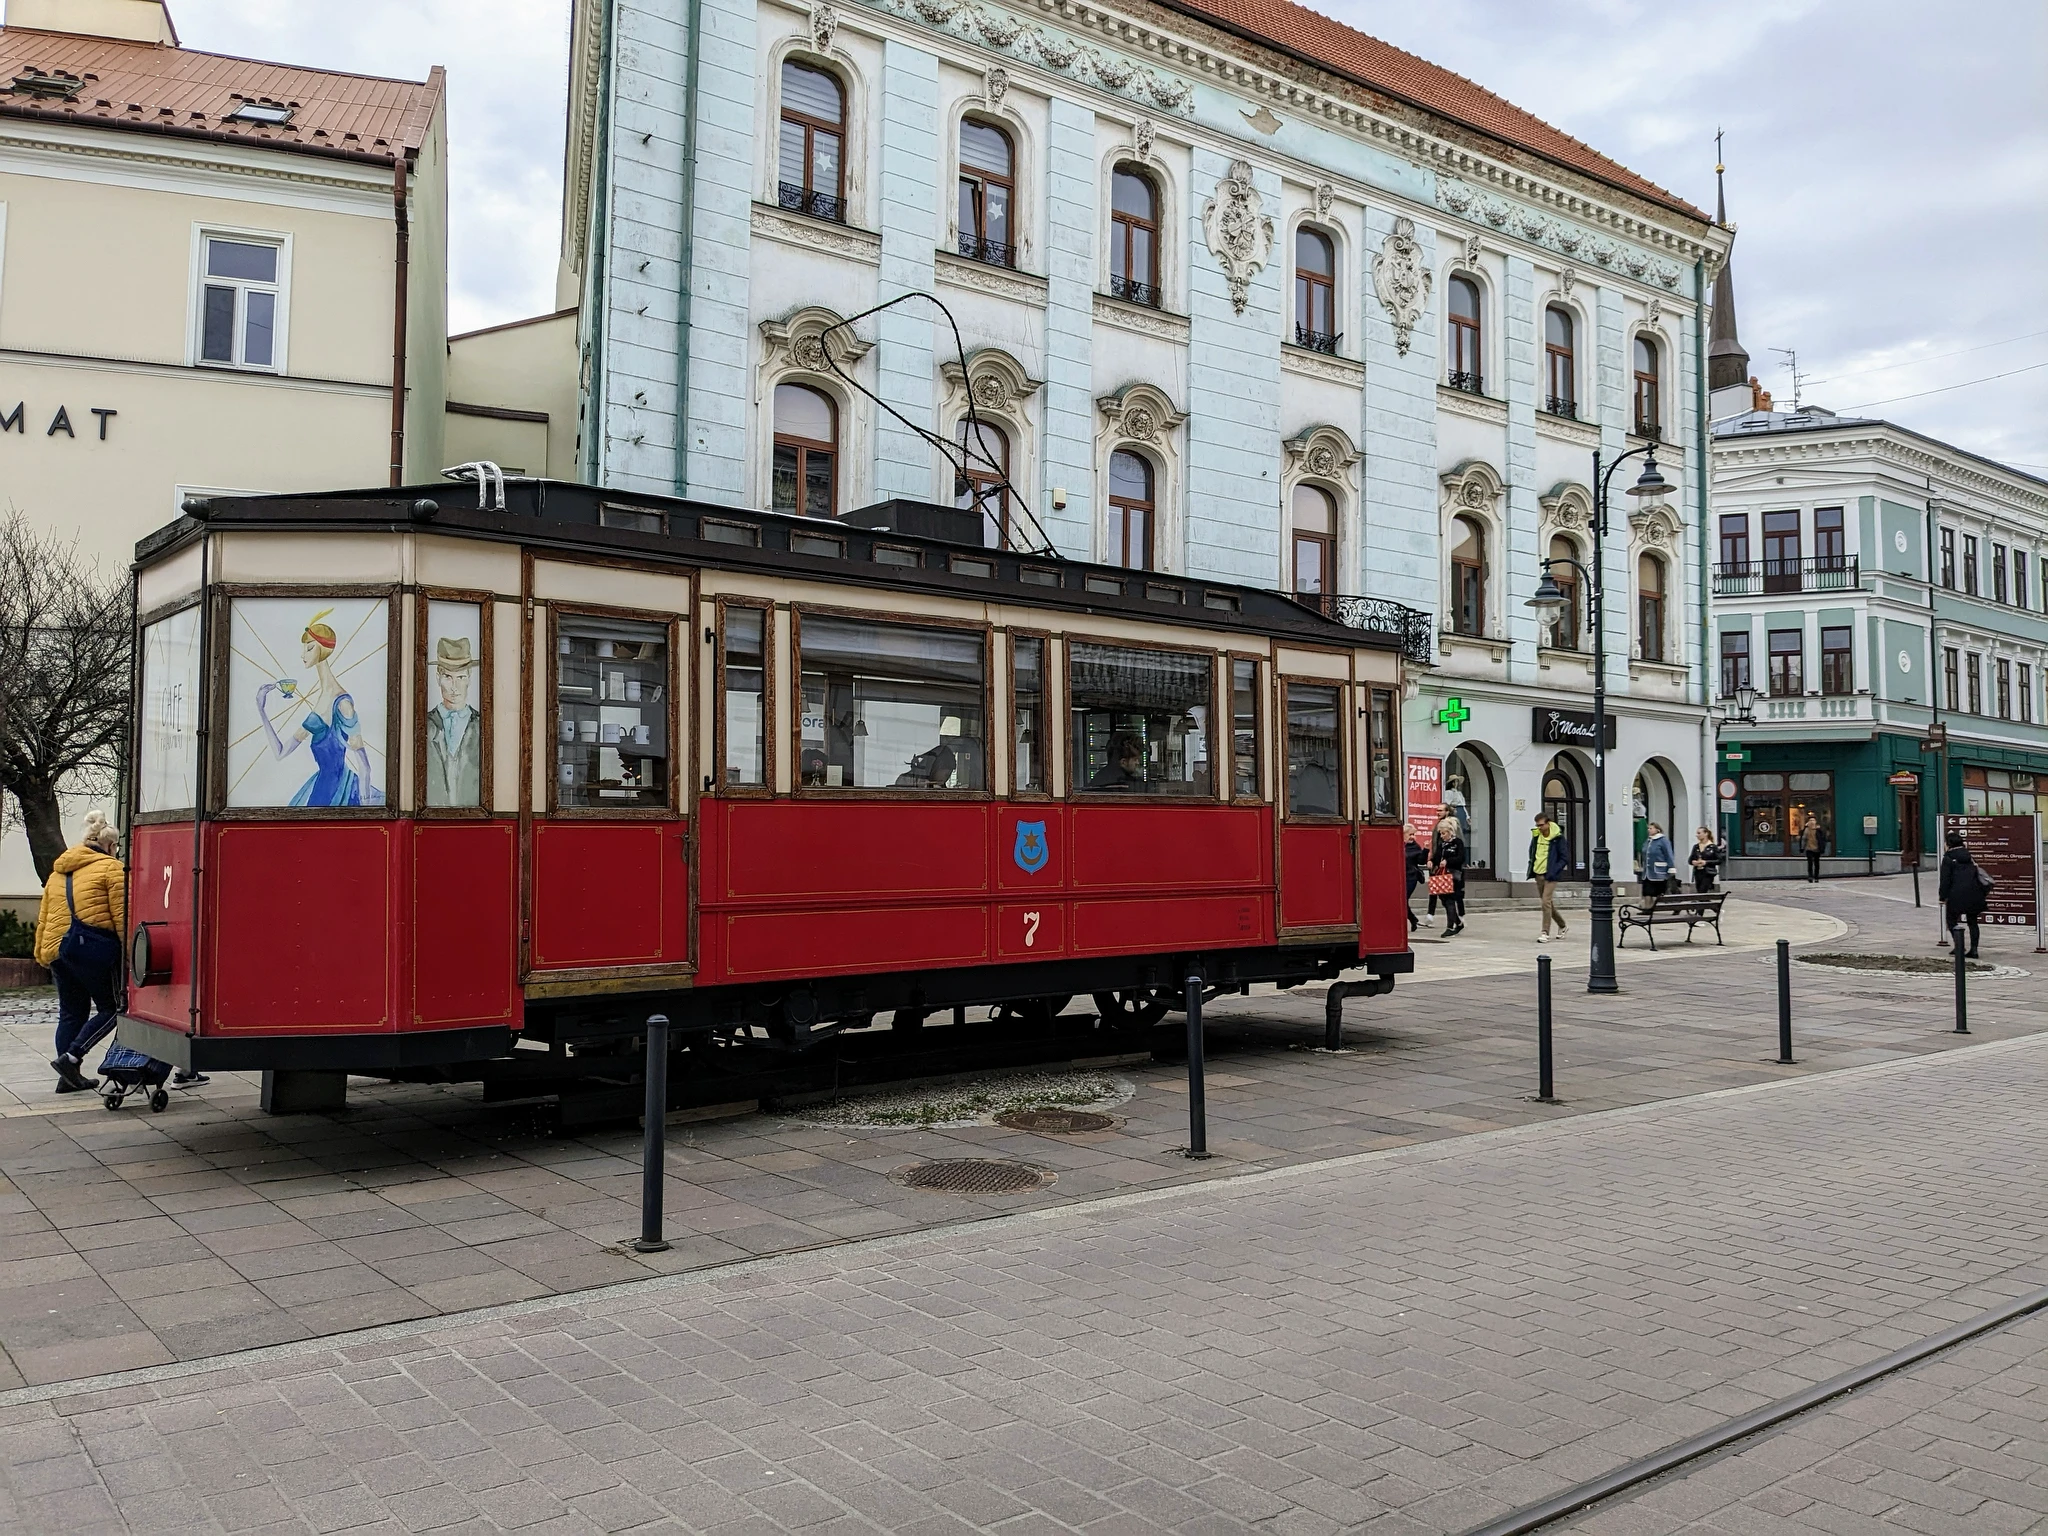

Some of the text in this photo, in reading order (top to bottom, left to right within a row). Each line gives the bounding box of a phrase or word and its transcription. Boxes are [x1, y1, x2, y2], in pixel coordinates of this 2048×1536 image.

[1410, 782, 1438, 792] APTEKA
[163, 865, 173, 909] 7
[1023, 912, 1040, 947] 7
